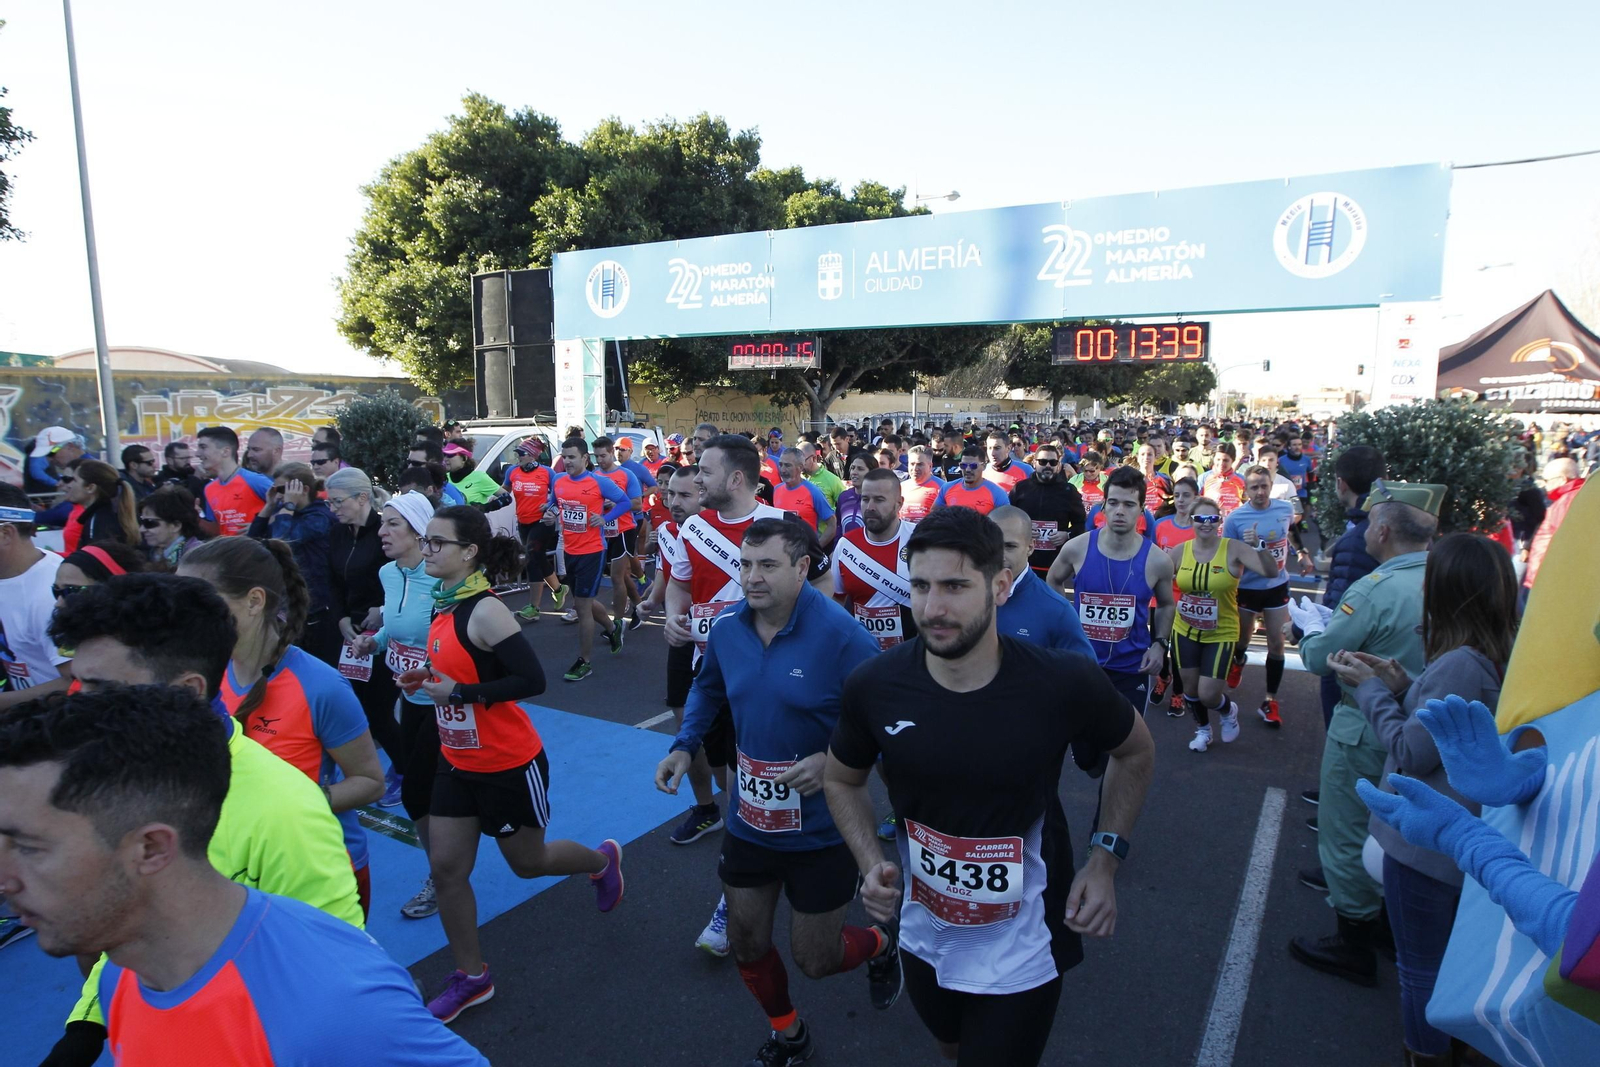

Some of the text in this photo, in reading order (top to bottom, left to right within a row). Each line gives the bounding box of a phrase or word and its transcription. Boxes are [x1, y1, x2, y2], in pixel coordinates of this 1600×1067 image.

[1105, 226, 1170, 246] MEDIO
[865, 239, 982, 274] ALMERÍA
[1105, 240, 1206, 265] MARATÓN
[710, 262, 752, 276] MEDIO
[1105, 260, 1193, 284] ALMERÍA
[710, 272, 775, 292] MARATÓN
[865, 275, 923, 293] CIUDAD
[710, 290, 767, 307] ALMERÍA
[1076, 325, 1202, 361] 00:13:39
[1391, 374, 1415, 385] CDX
[722, 411, 729, 421] EL
[563, 510, 584, 520] 5729
[688, 523, 742, 572] GALGOS R
[842, 547, 881, 580] GALGOS
[1085, 605, 1129, 622] 5785
[1181, 602, 1213, 616] 5404
[388, 651, 419, 672] 6138
[740, 770, 791, 802] 5439
[965, 851, 1015, 859] SALUDABLE
[975, 843, 1014, 851] CARRERA
[920, 847, 1010, 893] 5438
[945, 884, 973, 897] ADGZ
